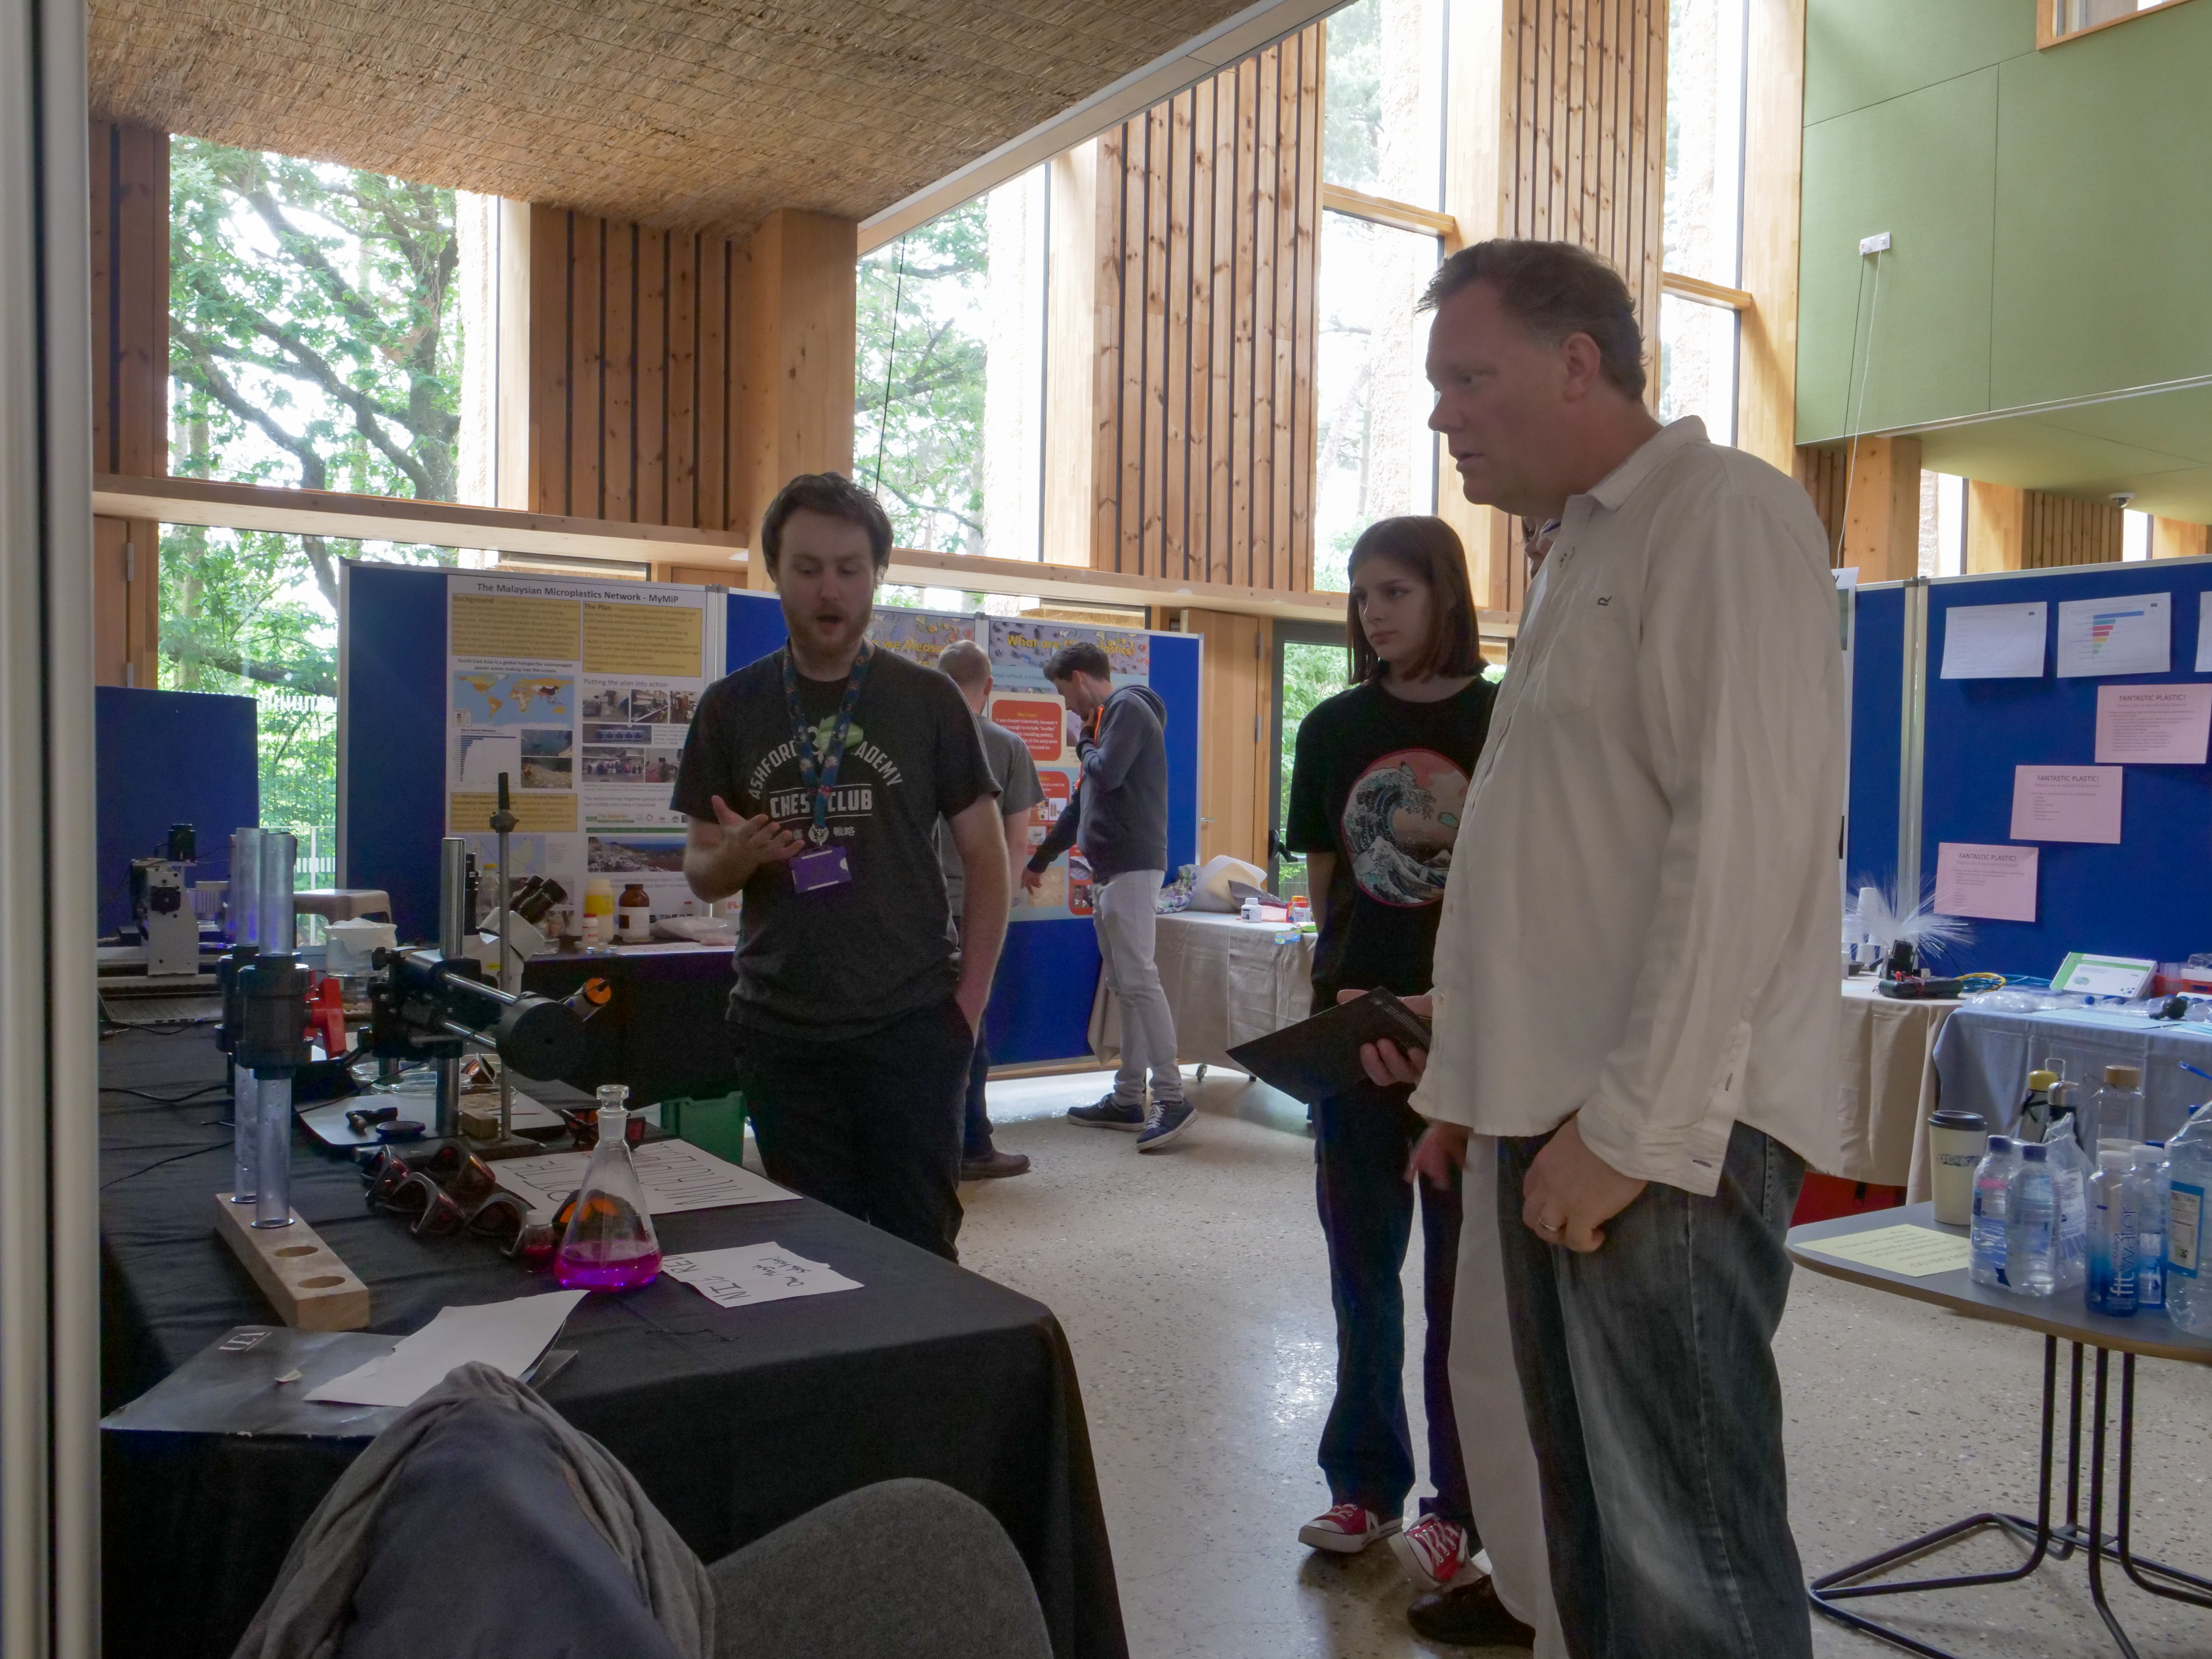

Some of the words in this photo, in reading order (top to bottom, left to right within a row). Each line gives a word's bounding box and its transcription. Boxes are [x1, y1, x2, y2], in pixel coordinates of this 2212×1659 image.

[453, 596, 494, 604] Background
[497, 585, 541, 595] Malaysian
[544, 588, 602, 598] Microplastics
[605, 592, 641, 601] Network
[649, 595, 678, 603] MyMiP
[882, 640, 900, 649] we
[1007, 634, 1037, 647] What
[1041, 639, 1060, 649] are
[853, 741, 902, 786] ADEMY
[770, 794, 811, 818] CHES
[827, 789, 872, 812] CLUB
[218, 1332, 267, 1350] UEA
